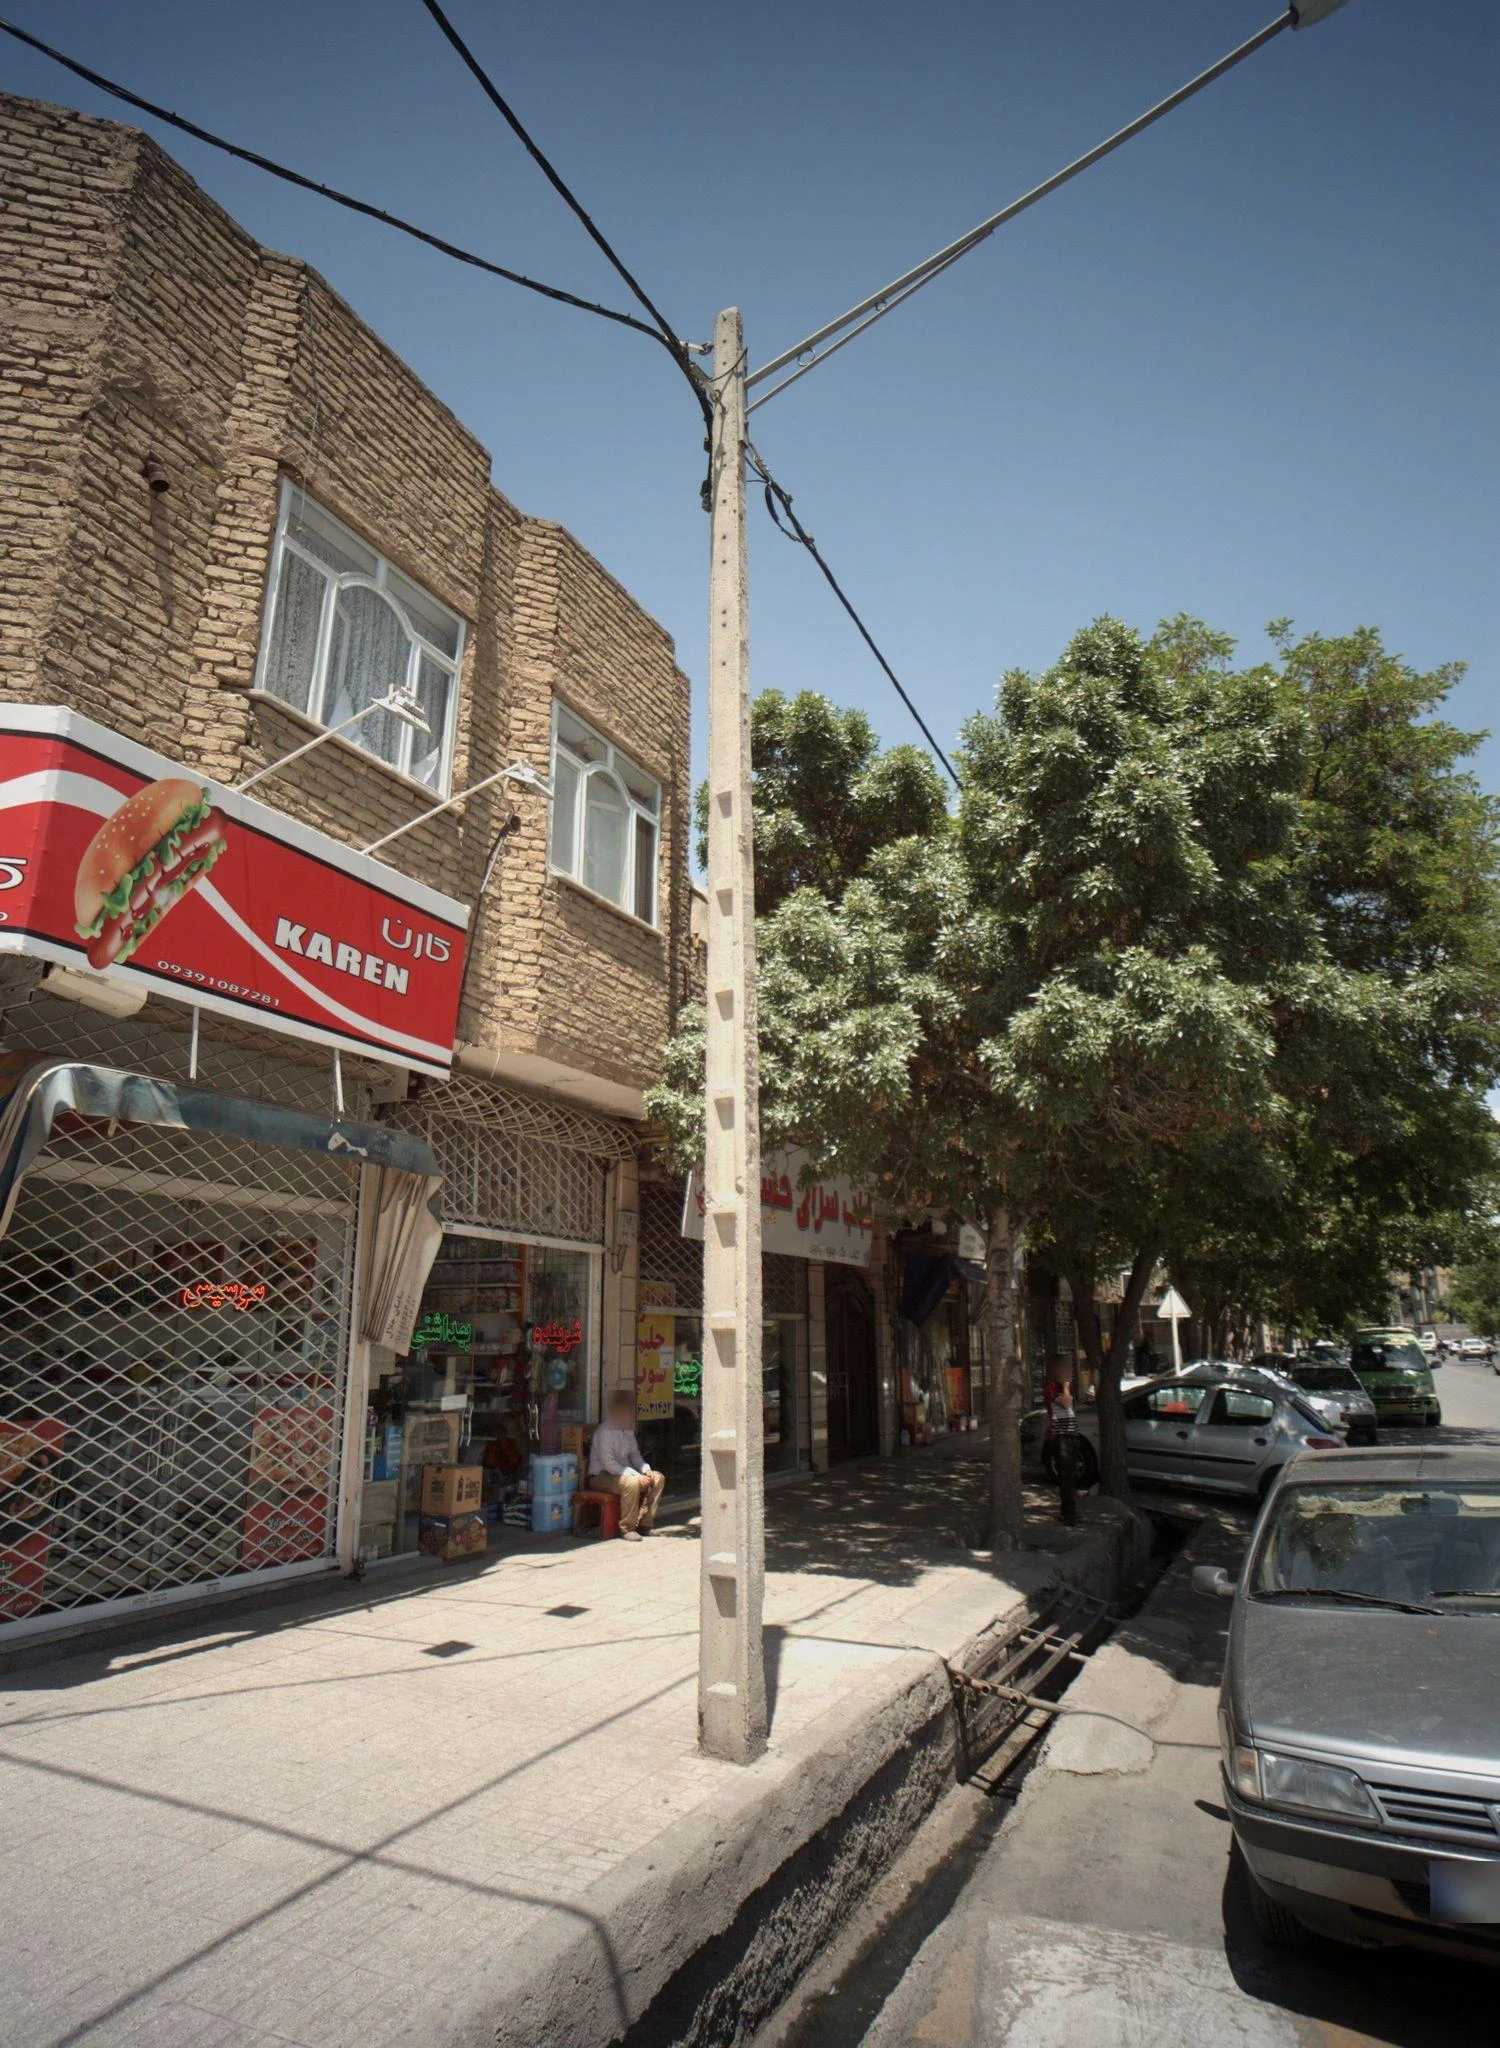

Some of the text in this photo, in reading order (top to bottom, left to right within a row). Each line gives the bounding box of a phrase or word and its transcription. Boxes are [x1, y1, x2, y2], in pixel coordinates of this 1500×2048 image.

[274, 916, 410, 996] KAREN
[382, 917, 451, 962] کارن
[156, 960, 280, 1007] 09391087281
[409, 1312, 472, 1352] بهداشتی
[533, 1318, 583, 1354] شوینده
